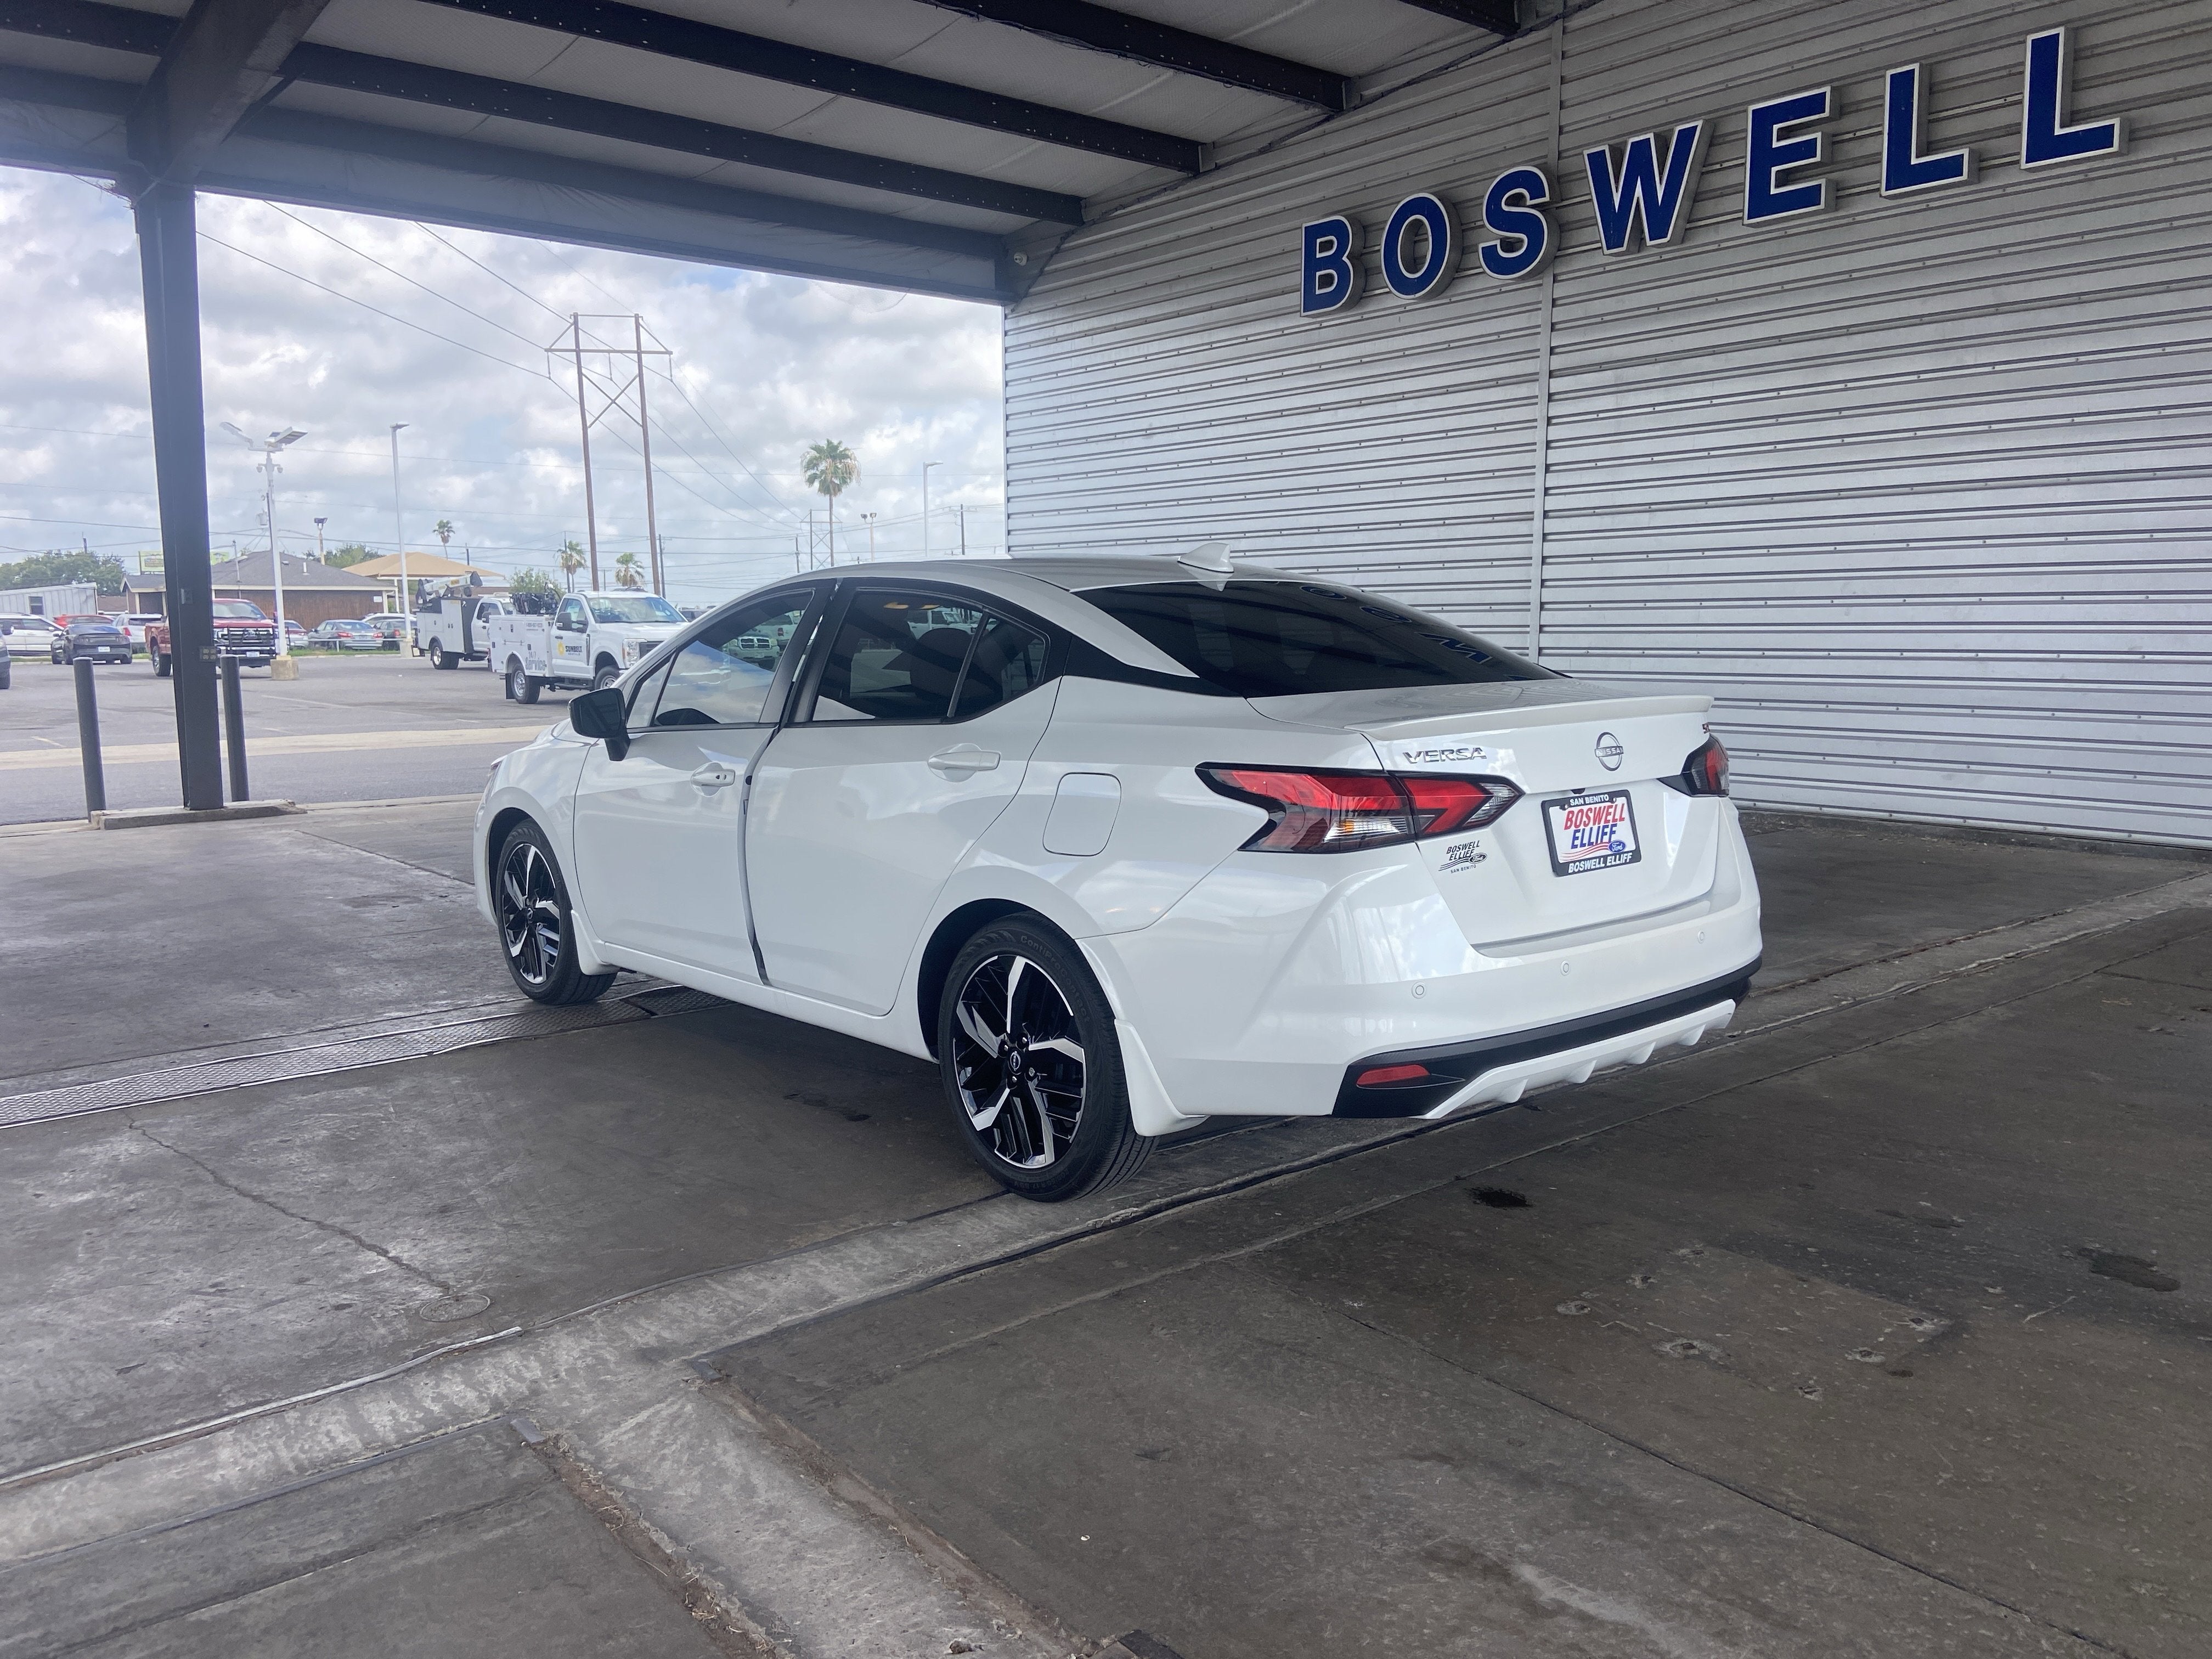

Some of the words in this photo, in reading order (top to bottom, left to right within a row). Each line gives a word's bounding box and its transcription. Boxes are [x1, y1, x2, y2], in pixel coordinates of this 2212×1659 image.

[1300, 26, 2121, 317] BOSWELL
[526, 657, 546, 670] Service
[1403, 747, 1487, 764] VERSA
[1585, 794, 1609, 804] BENITO
[1564, 803, 1626, 830] BOSWELL
[1571, 823, 1618, 849] ELLIFF
[1446, 840, 1480, 854] BOSWELL
[1449, 849, 1475, 861] ELLIFF
[1611, 842, 1623, 851] Ford
[1568, 857, 1605, 873] BOSWELL
[1606, 853, 1633, 866] ELLIFF
[1020, 935, 1090, 1023] ContiProContact
